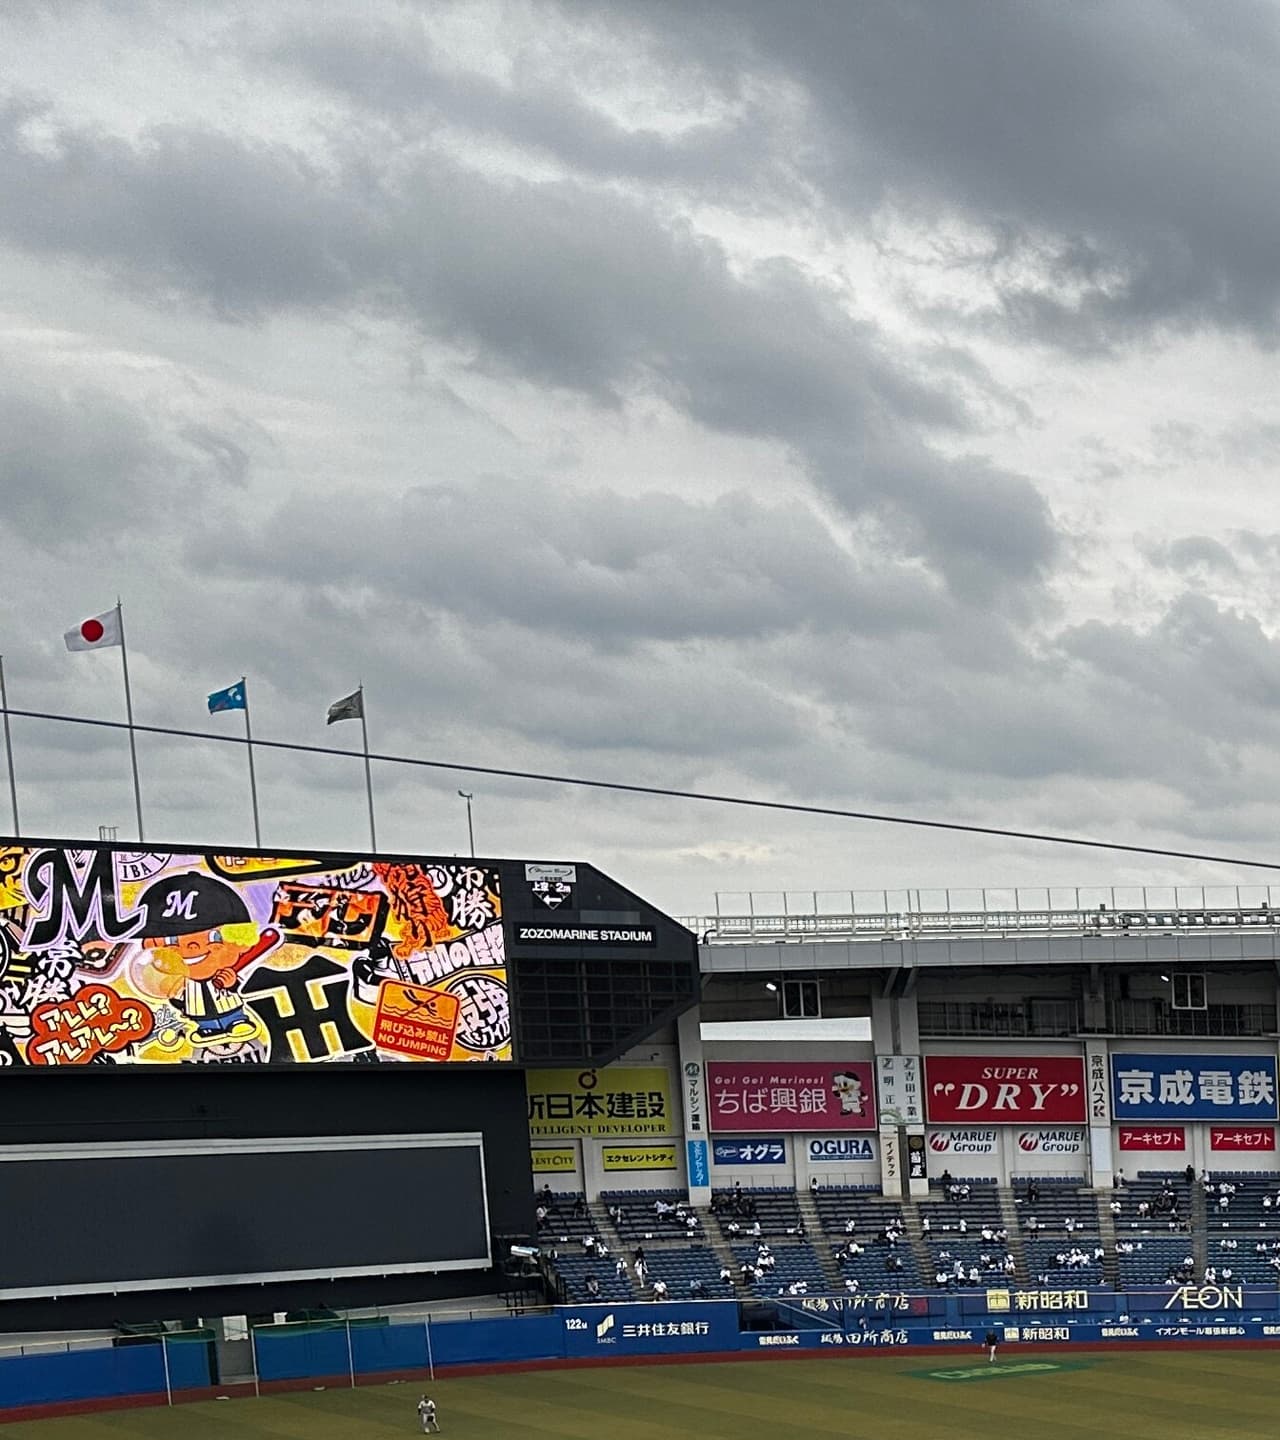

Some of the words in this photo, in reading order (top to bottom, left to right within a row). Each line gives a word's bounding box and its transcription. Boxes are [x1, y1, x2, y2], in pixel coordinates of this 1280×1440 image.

[520, 928, 599, 941] ZOZOMARINE
[600, 930, 652, 942] STADIUM
[379, 1018, 449, 1046] 飛び込み禁止
[378, 1032, 395, 1045] NO
[396, 1037, 448, 1057] JUMPING
[715, 1076, 736, 1085] Go!
[742, 1076, 763, 1085] Go!
[770, 1076, 824, 1085] Marines!
[982, 1067, 1038, 1080] SUPER
[1091, 1055, 1106, 1106] 京成バス
[1117, 1069, 1275, 1105] 京成電鉄
[688, 1078, 701, 1131] マルシン運輸
[715, 1088, 828, 1115] ちば興銀
[598, 1124, 666, 1134] DEVELOPER
[950, 1131, 996, 1143] MARUEI
[1039, 1131, 1085, 1143] MARUEI
[1122, 1132, 1182, 1145] アーキセプト
[1213, 1132, 1272, 1145] アーキセプト
[739, 1143, 784, 1160] オグラ
[810, 1139, 873, 1155] OGURA
[954, 1141, 992, 1153] Group
[1042, 1141, 1080, 1153] Group
[606, 1153, 674, 1164] エクセレントシティ
[1014, 1290, 1089, 1310] 新昭和
[1164, 1286, 1243, 1309] ÆON
[622, 1321, 710, 1337] 三井住友銀行
[1022, 1327, 1070, 1341] 新昭和
